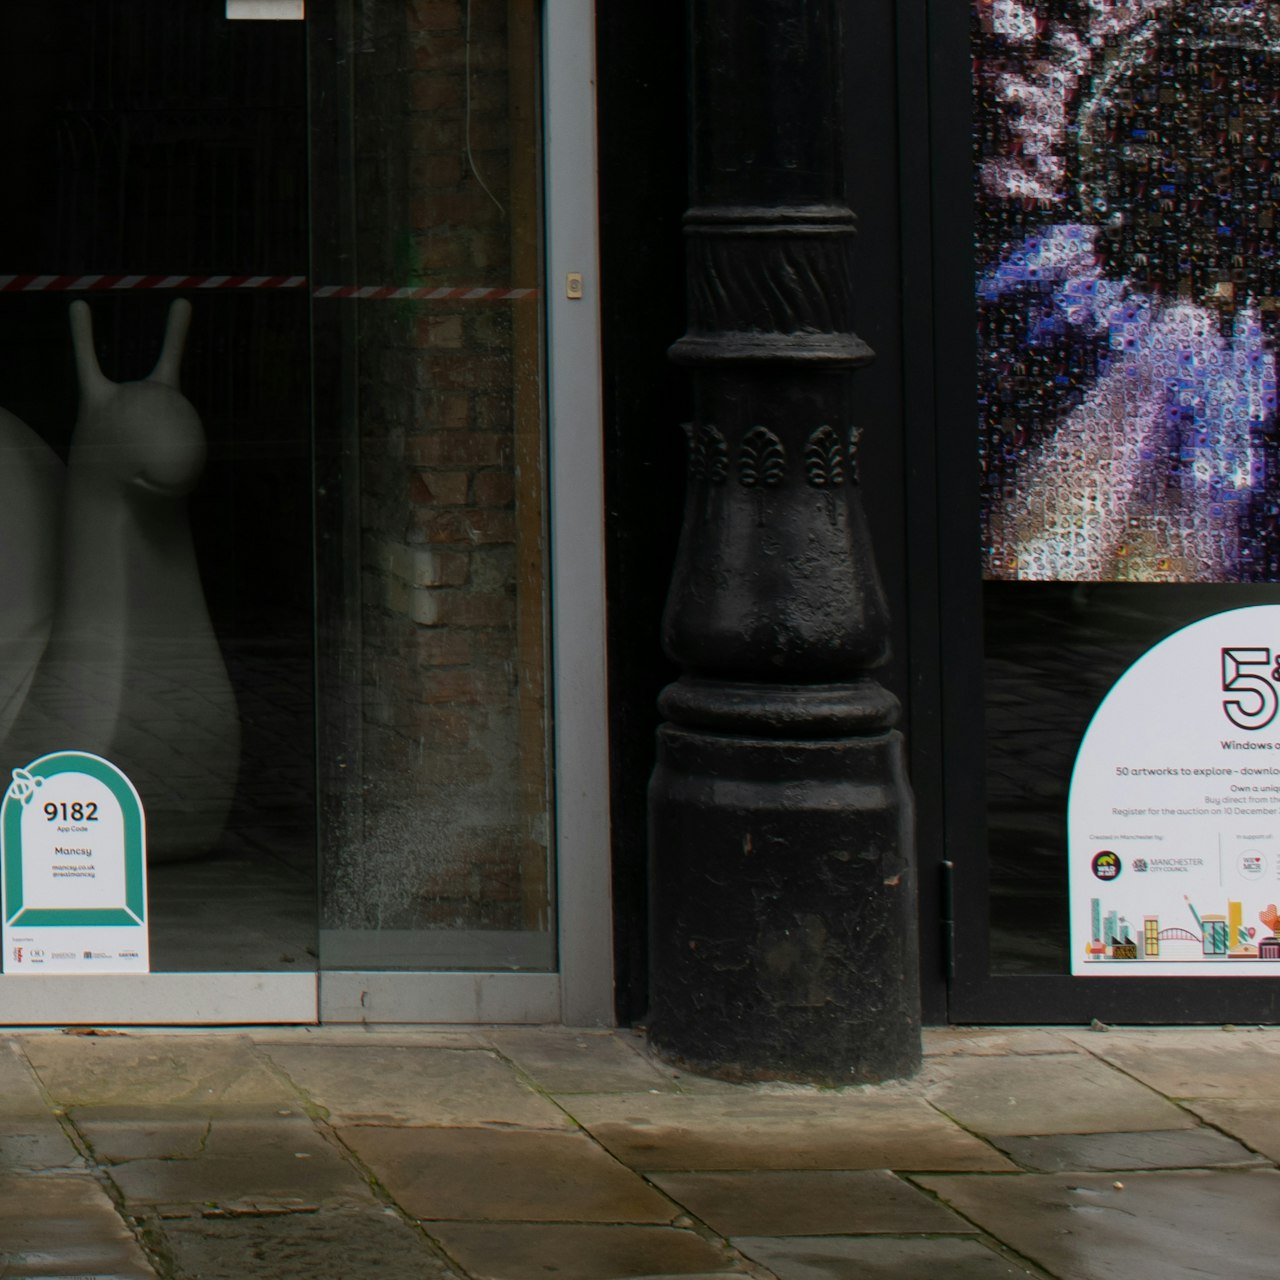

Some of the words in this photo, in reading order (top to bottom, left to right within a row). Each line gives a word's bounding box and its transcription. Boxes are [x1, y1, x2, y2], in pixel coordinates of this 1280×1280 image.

[1220, 740, 1273, 750] Windows
[1116, 767, 1129, 776] 50
[1130, 767, 1178, 776] artworks
[1180, 767, 1190, 776] to
[1193, 767, 1232, 778] explore
[1205, 796, 1220, 805] Buy
[1222, 796, 1247, 804] direct
[1248, 796, 1268, 804] from
[43, 801, 99, 821] 9182
[1112, 808, 1146, 817] Register
[54, 847, 92, 857] Mancsy
